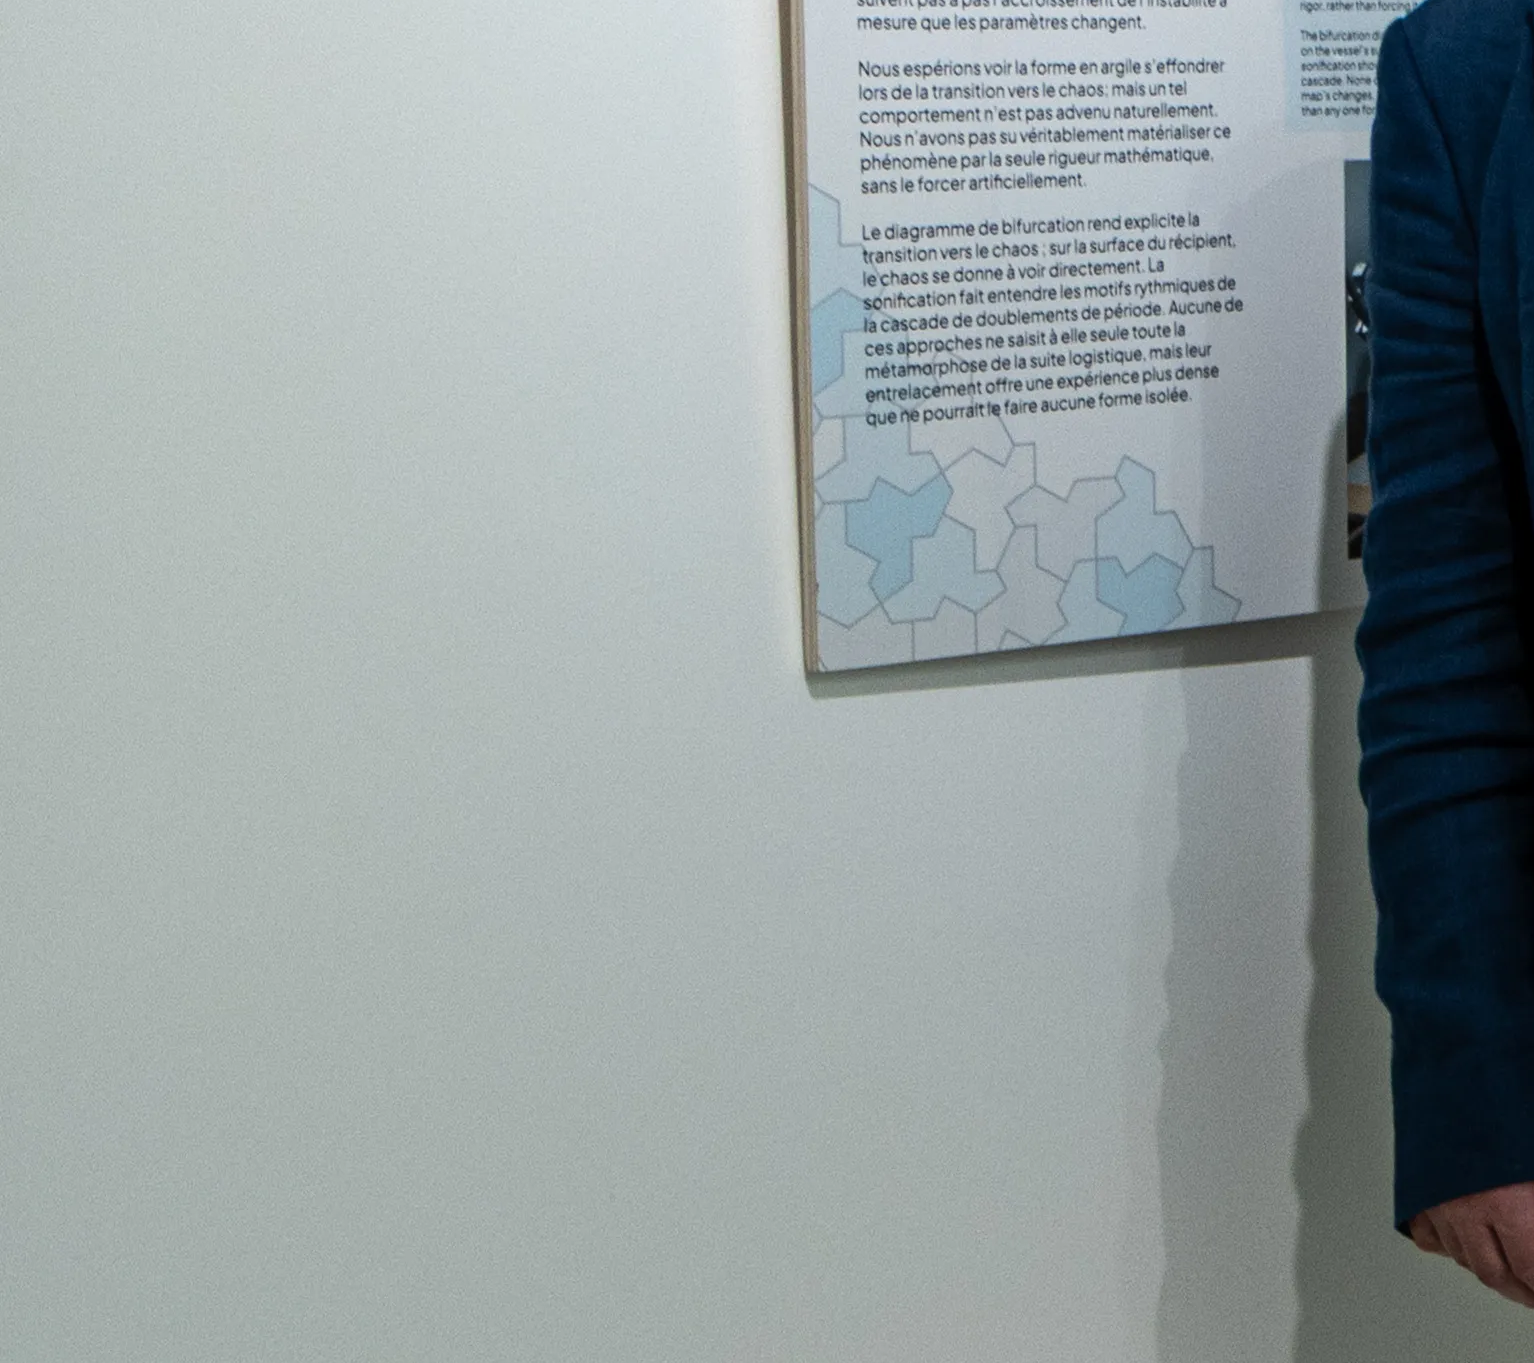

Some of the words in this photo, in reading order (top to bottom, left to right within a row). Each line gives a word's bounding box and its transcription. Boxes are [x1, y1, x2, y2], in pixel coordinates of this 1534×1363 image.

[856, 17, 917, 29] mesure
[920, 17, 951, 33] que
[953, 13, 976, 29] les
[978, 13, 1068, 33] paramètres
[858, 60, 900, 76] Nous
[902, 59, 981, 79] espérions
[983, 58, 1012, 75] voir
[1014, 58, 1028, 75] la
[1030, 58, 1076, 74] forme
[1078, 62, 1098, 74] en
[1100, 57, 1141, 77] argile
[858, 83, 888, 100] lors
[890, 83, 912, 99] de
[915, 82, 929, 99] la
[931, 81, 1005, 99] transition
[1006, 85, 1039, 98] vers
[1041, 81, 1056, 97] le
[1111, 80, 1146, 96] mais
[1148, 83, 1166, 96] un
[1167, 79, 1187, 96] tel
[858, 105, 981, 127] comportement
[1024, 107, 1053, 124] pas
[1055, 102, 1111, 120] advenu
[859, 129, 902, 147] Nous
[967, 131, 997, 147] pas
[999, 131, 1017, 143] su
[1019, 124, 1124, 143] véritablement
[1126, 122, 1211, 140] matérialiser
[1212, 126, 1231, 138] ce
[859, 151, 958, 173] phénomène
[960, 154, 986, 171] par
[988, 150, 1002, 166] la
[1004, 149, 1046, 166] seule
[1048, 147, 1101, 168] rigueur
[860, 180, 897, 193] sans
[900, 175, 915, 192] le
[917, 174, 966, 192] forcer
